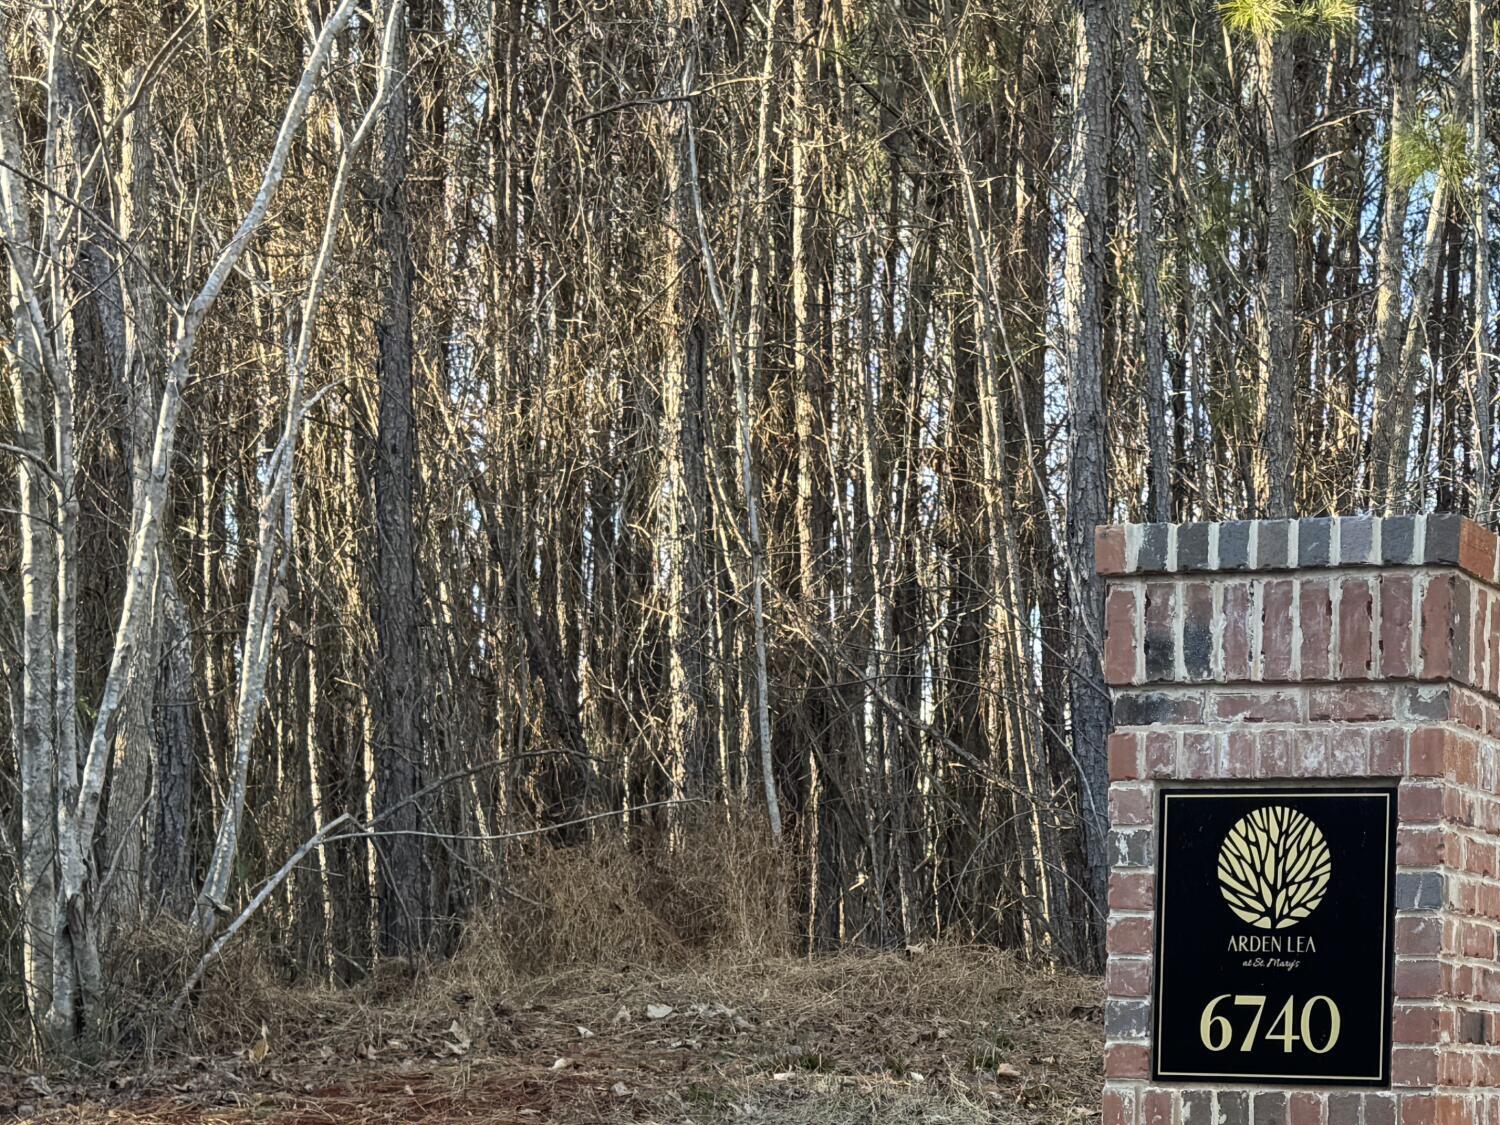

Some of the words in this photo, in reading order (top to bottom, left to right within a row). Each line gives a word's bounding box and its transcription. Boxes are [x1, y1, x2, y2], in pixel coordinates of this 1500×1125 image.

[1228, 935, 1281, 953] ARDEN
[1287, 935, 1316, 953] LEA
[1242, 958, 1253, 967] at
[1253, 957, 1265, 967] St.
[1266, 957, 1300, 971] Mary's
[1199, 993, 1341, 1054] 6740
